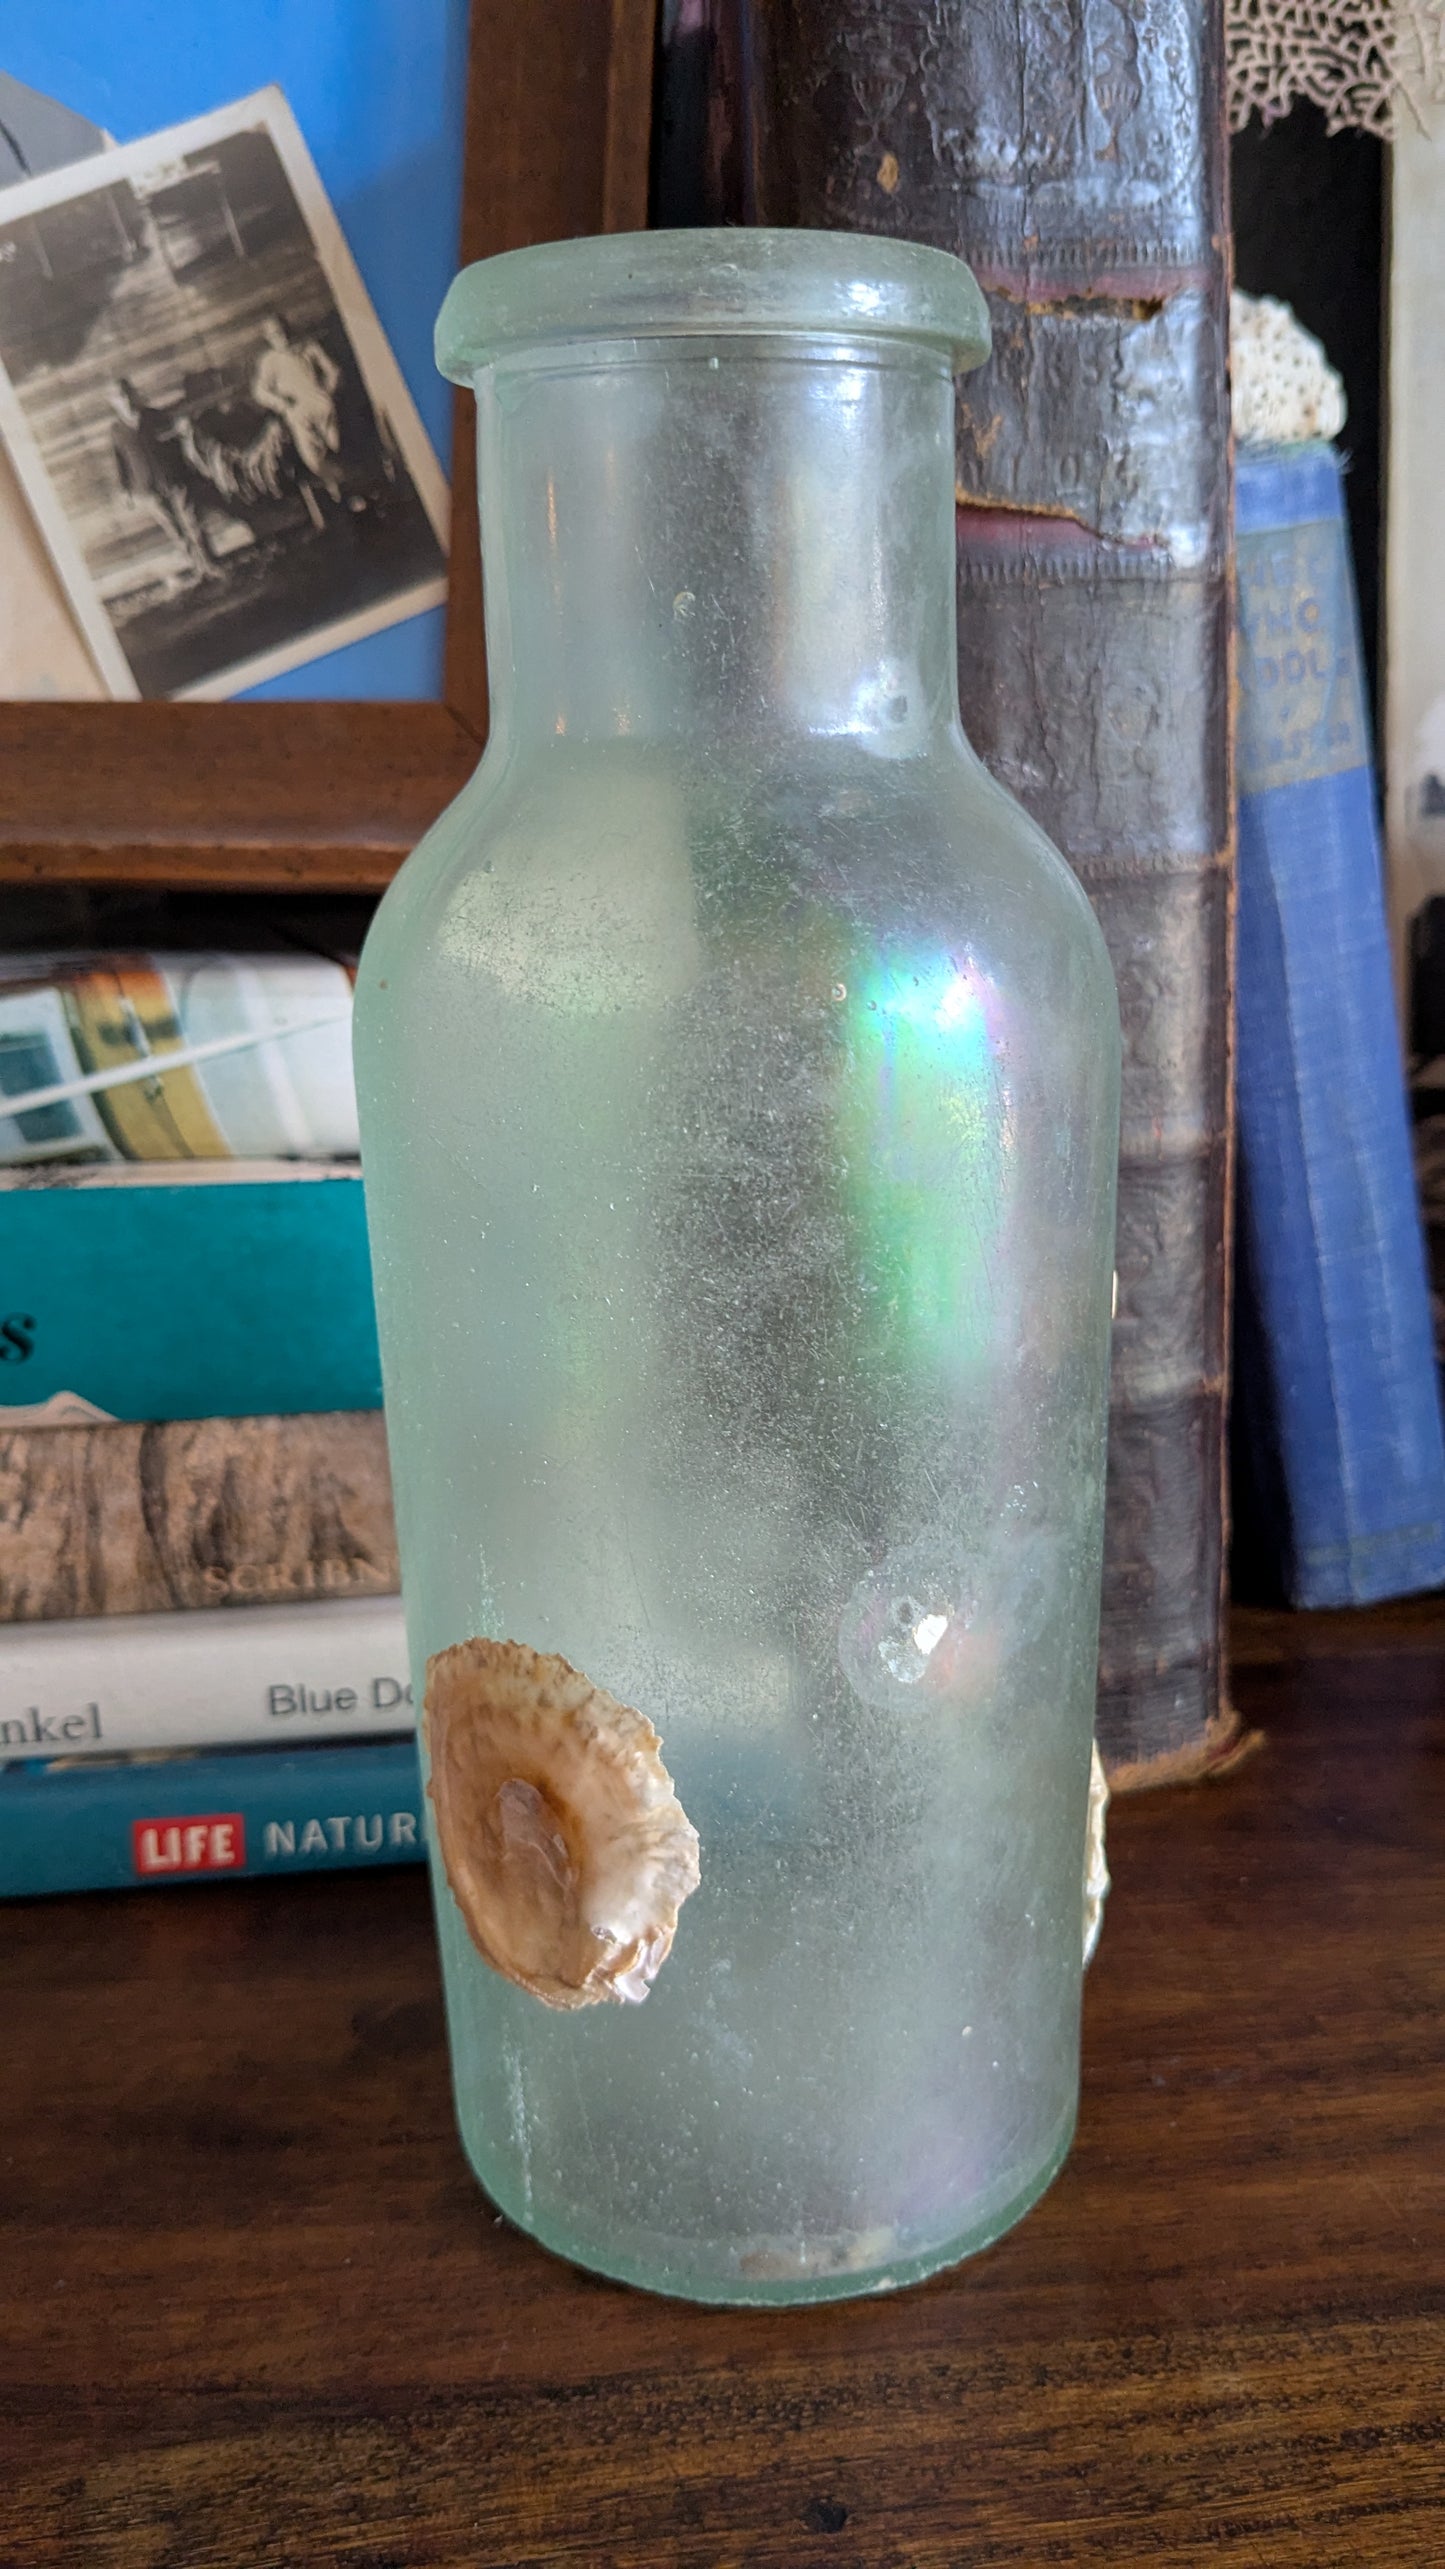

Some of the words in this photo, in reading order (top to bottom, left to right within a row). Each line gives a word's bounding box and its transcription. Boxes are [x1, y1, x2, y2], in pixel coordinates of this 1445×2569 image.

[267, 1682, 358, 1716] Blue
[0, 1702, 103, 1744] nkel
[141, 1824, 235, 1871] LIFE
[263, 1812, 427, 1857] NATUR
